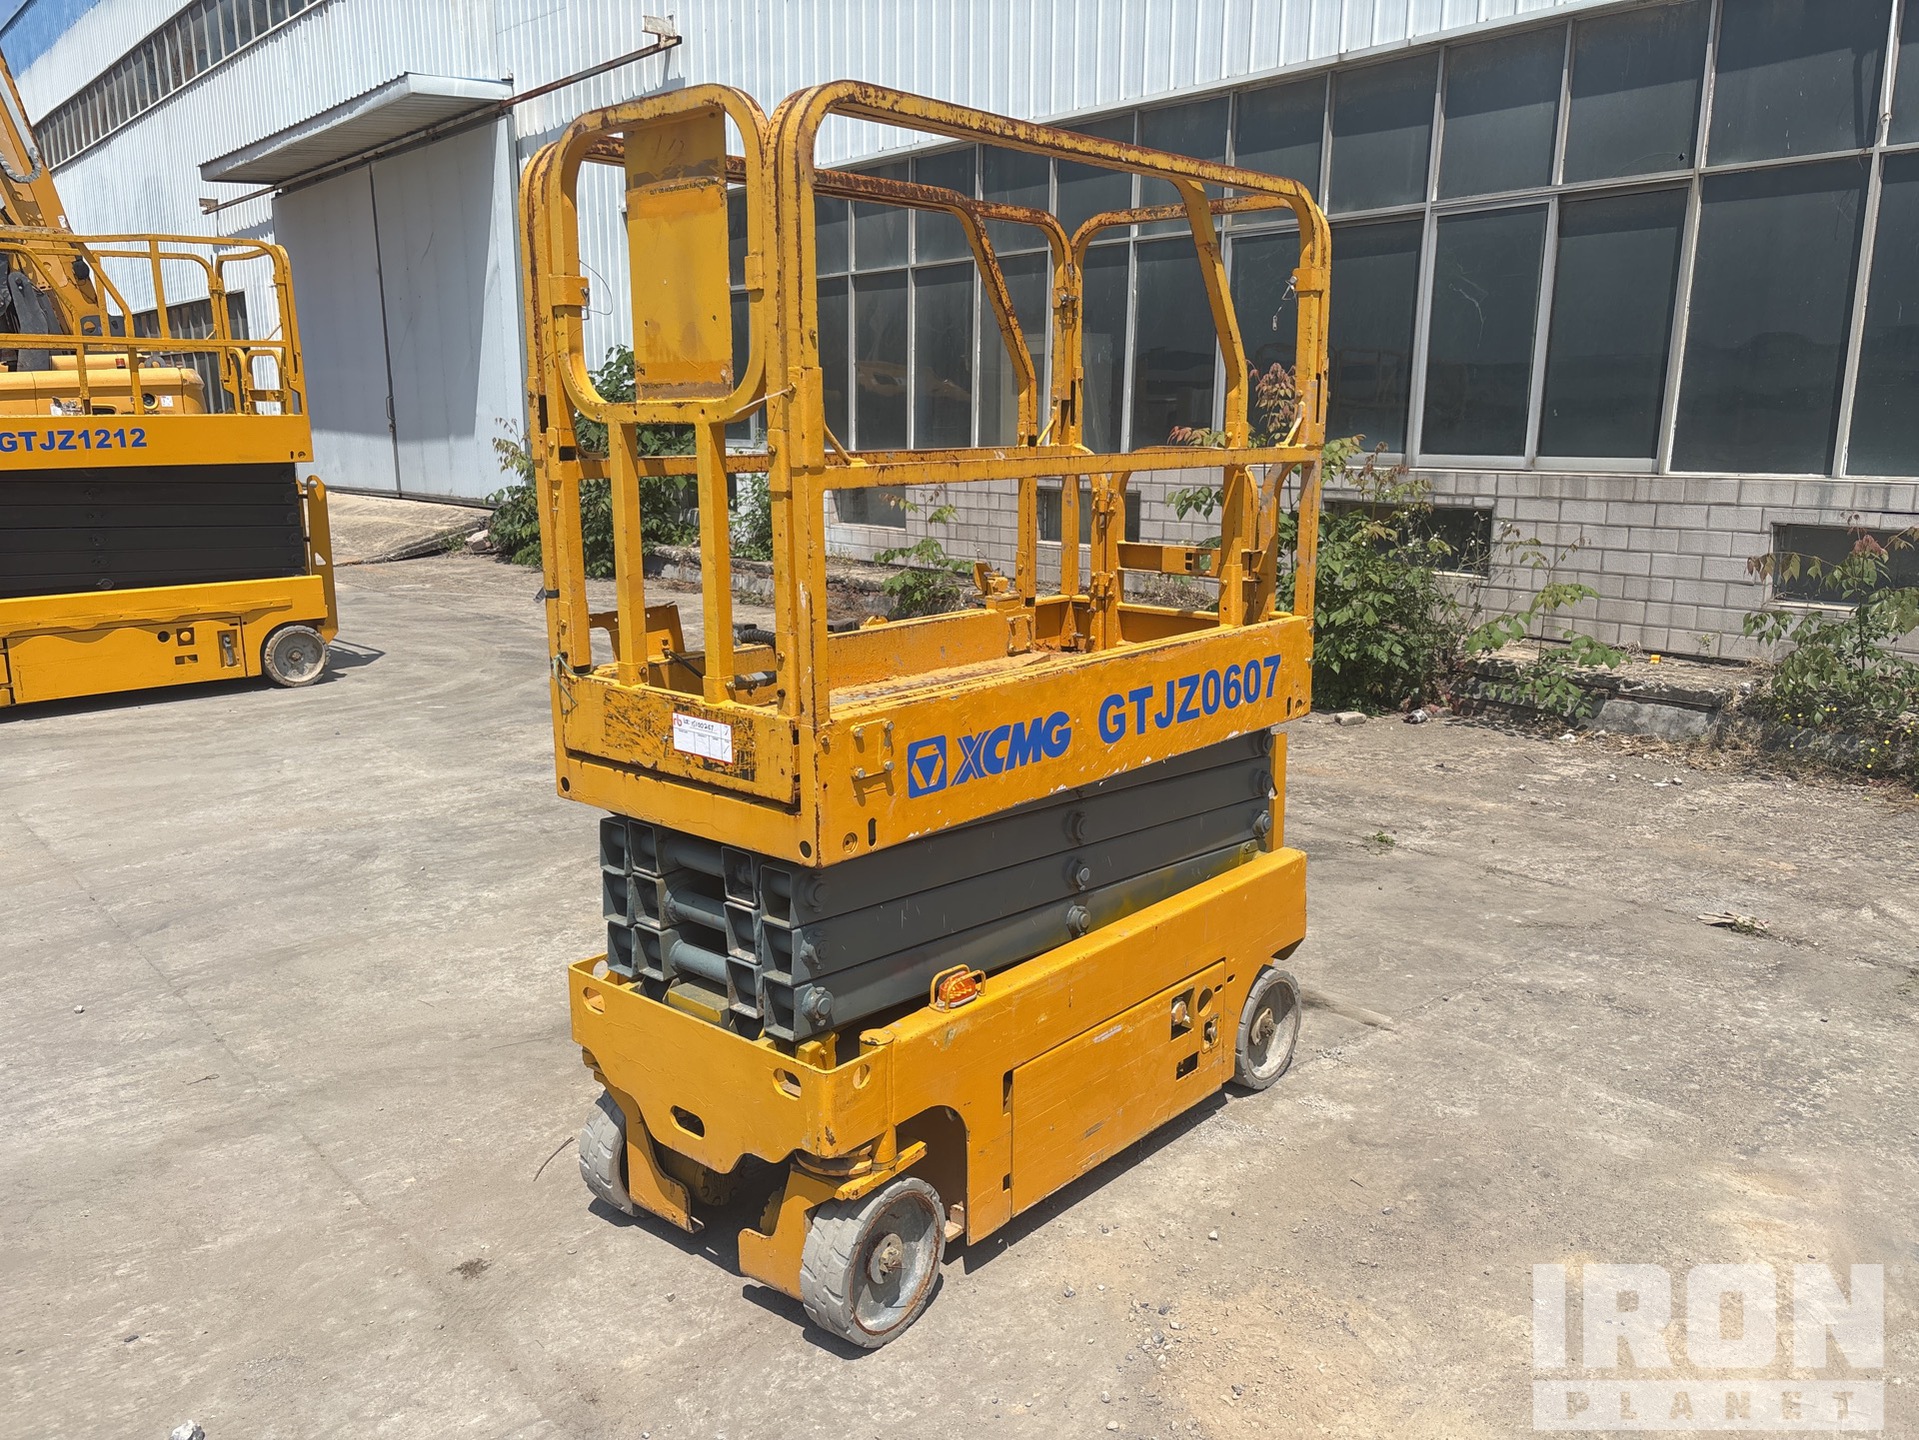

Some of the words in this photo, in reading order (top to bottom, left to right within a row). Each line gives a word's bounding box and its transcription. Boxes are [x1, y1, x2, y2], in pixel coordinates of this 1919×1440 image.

[0, 428, 147, 452] GTJZ1212
[950, 711, 1072, 786] XCMG
[1099, 654, 1281, 743] GTJZ0607
